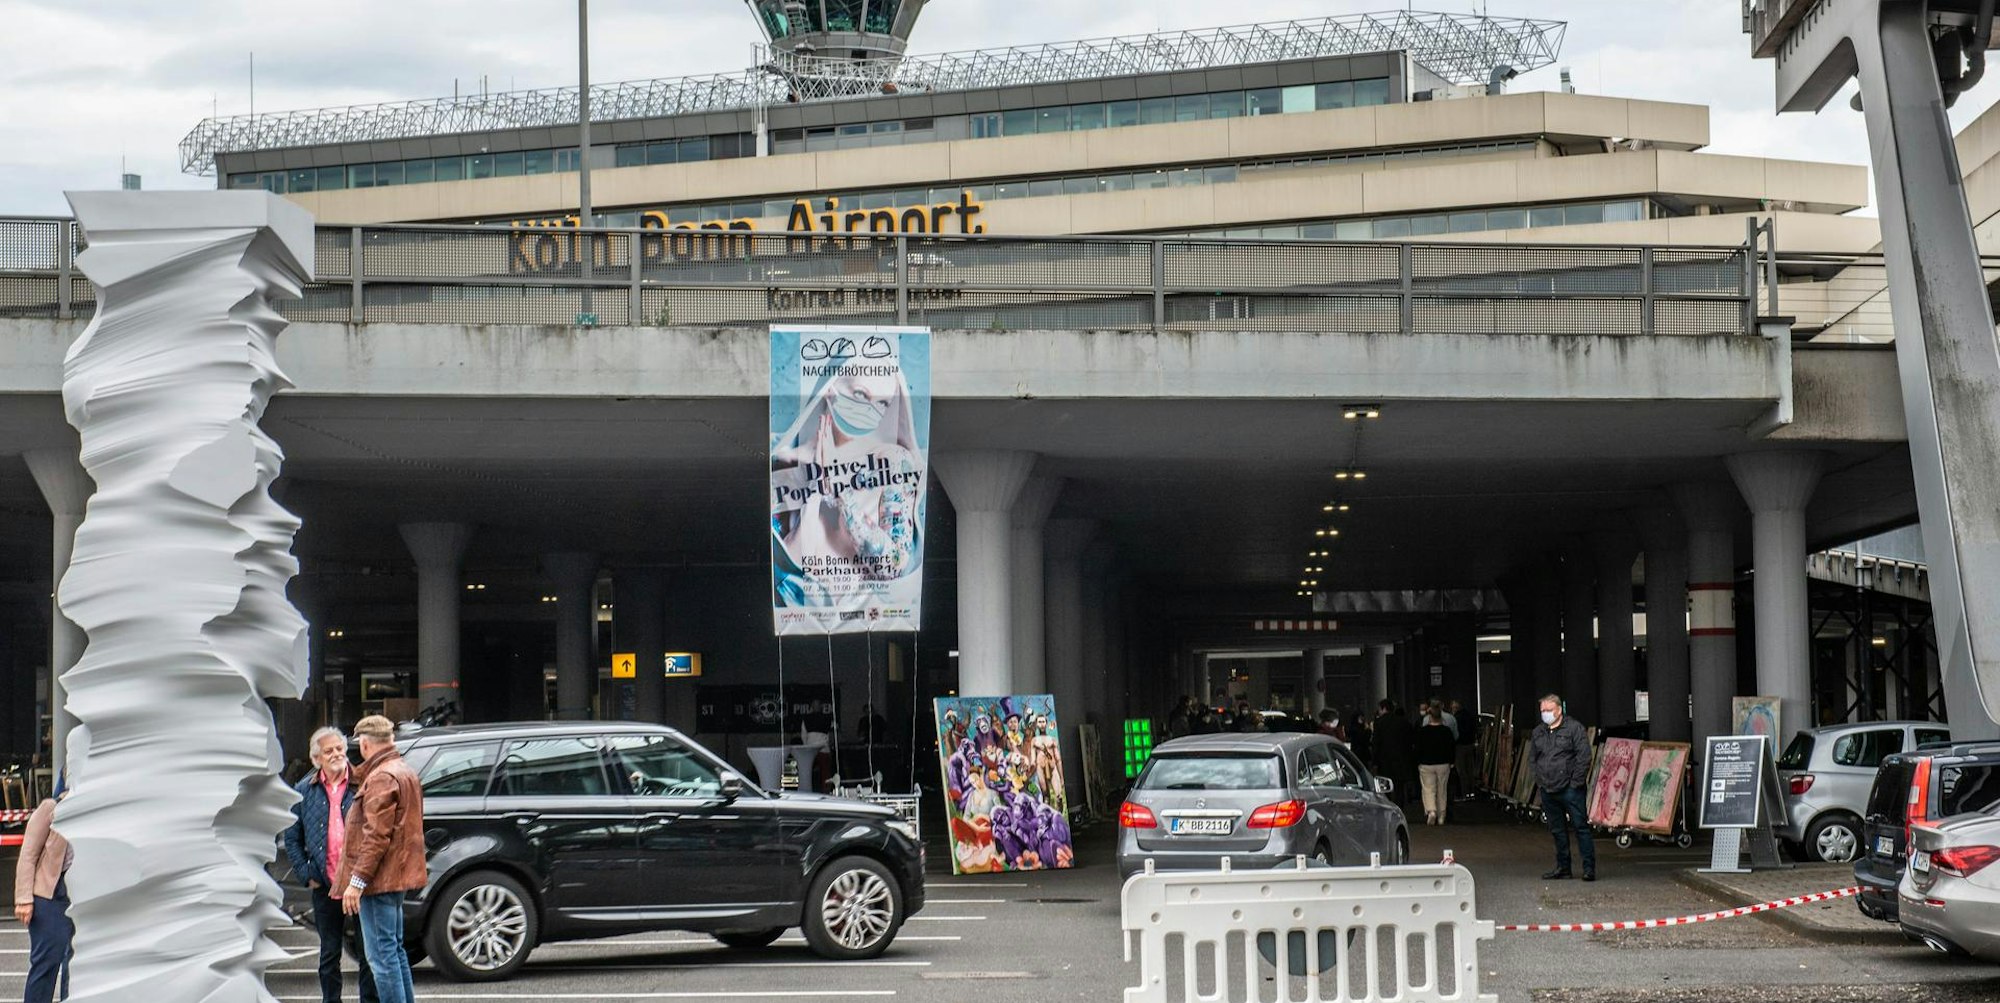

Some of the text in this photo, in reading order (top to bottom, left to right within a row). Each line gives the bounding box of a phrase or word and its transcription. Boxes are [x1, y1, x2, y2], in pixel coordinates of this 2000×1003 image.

[640, 210, 757, 270] Bonn
[787, 191, 987, 256] Airport
[804, 453, 890, 482] Drive-In
[775, 469, 923, 503] Pop-Up-Gallery
[801, 553, 891, 567] Köln Bonn Airport
[802, 566, 870, 577] Parkhaus
[1179, 821, 1229, 830] K BB 2116
